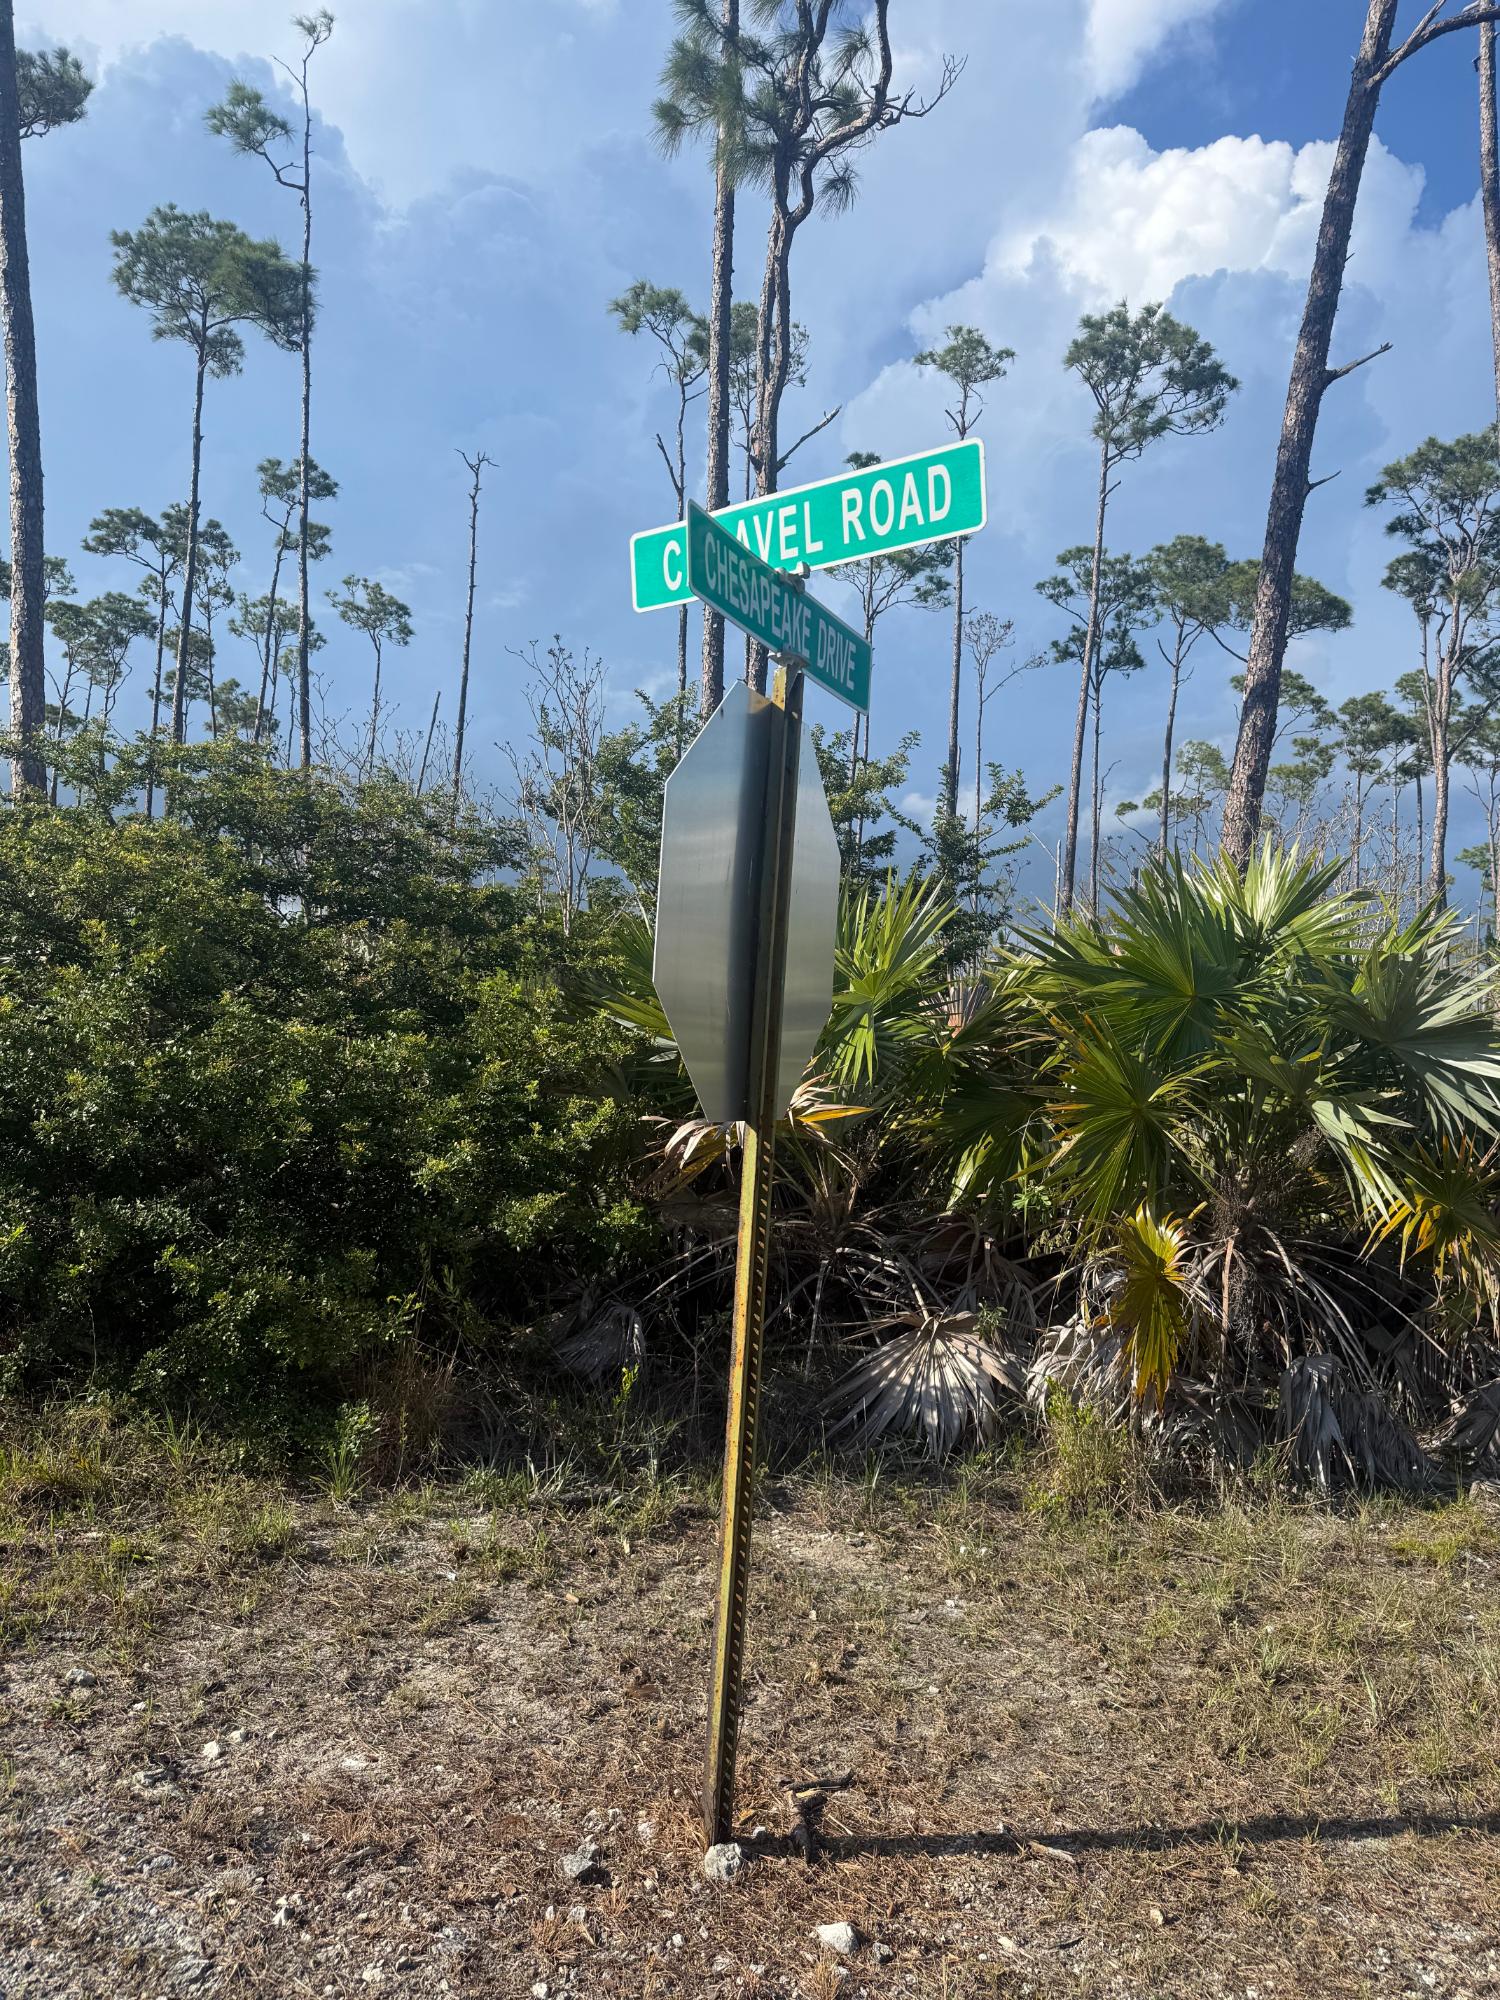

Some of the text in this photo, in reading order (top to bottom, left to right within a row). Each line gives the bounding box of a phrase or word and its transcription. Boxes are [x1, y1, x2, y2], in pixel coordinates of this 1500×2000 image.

[663, 464, 952, 591] CAVEL ROAD
[704, 532, 857, 691] CHESAPEAKE DRIVE
